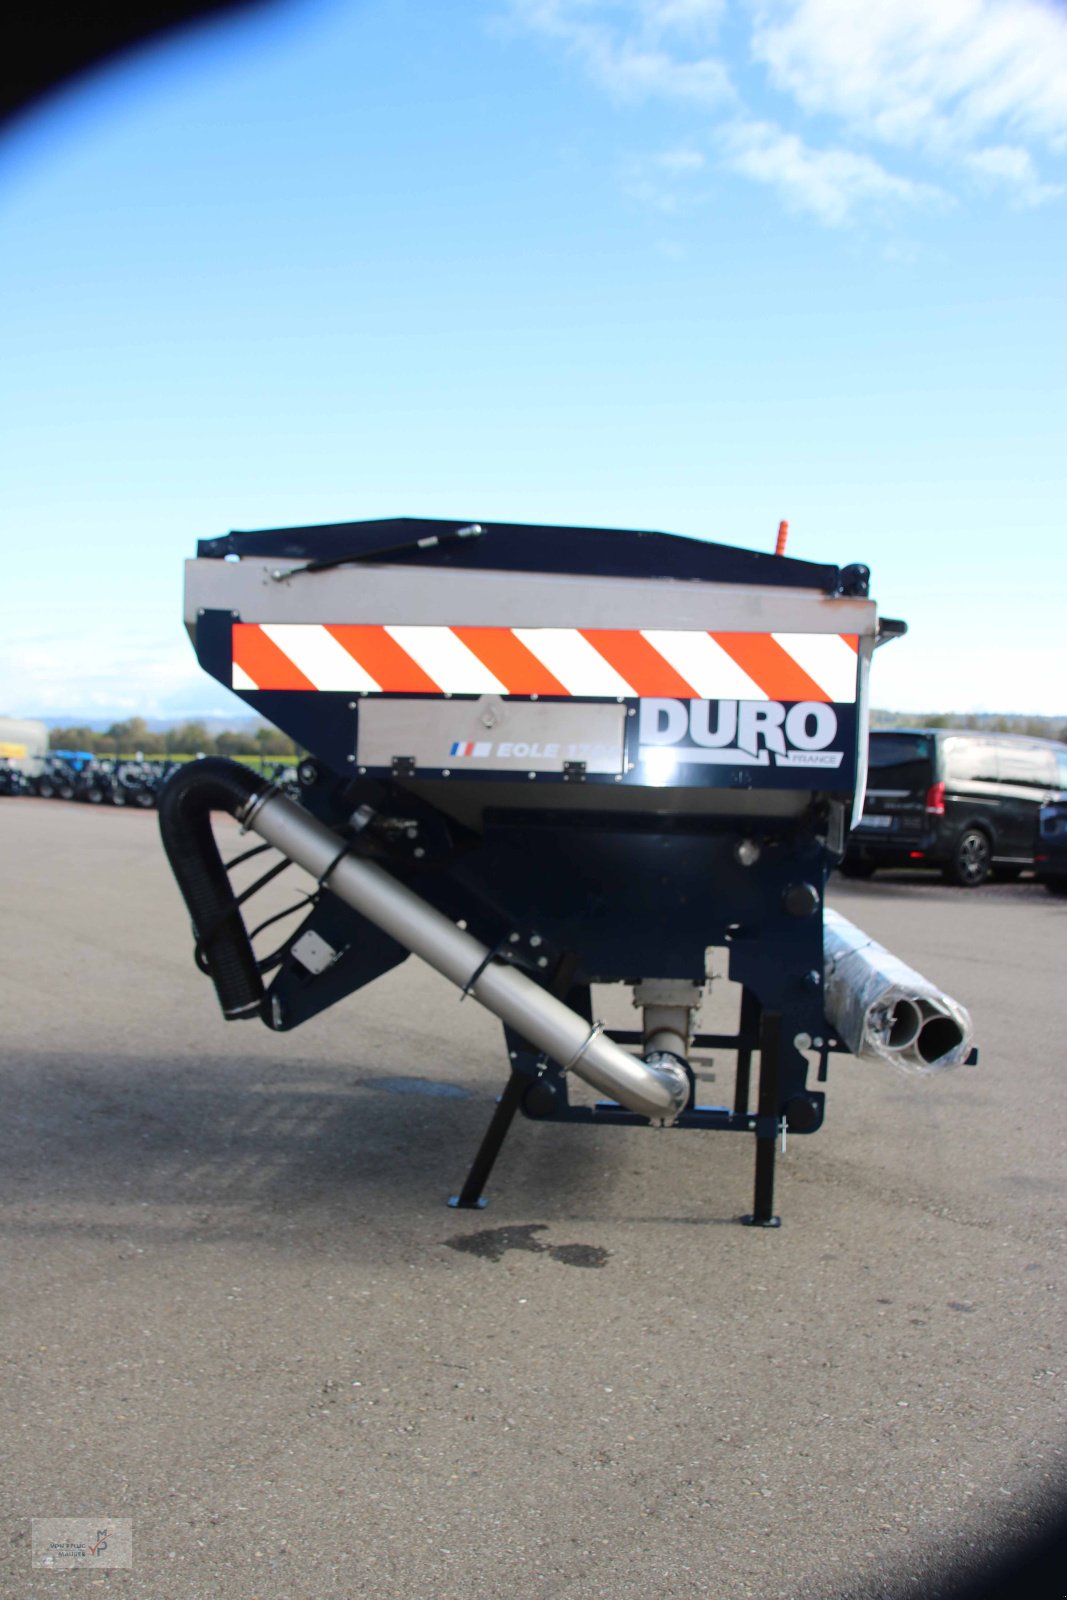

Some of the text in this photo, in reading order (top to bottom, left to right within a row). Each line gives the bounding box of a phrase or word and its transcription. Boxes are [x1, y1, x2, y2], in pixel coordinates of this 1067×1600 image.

[639, 697, 838, 759] DURO
[496, 742, 560, 758] EOLE
[792, 755, 838, 764] FRANCE
